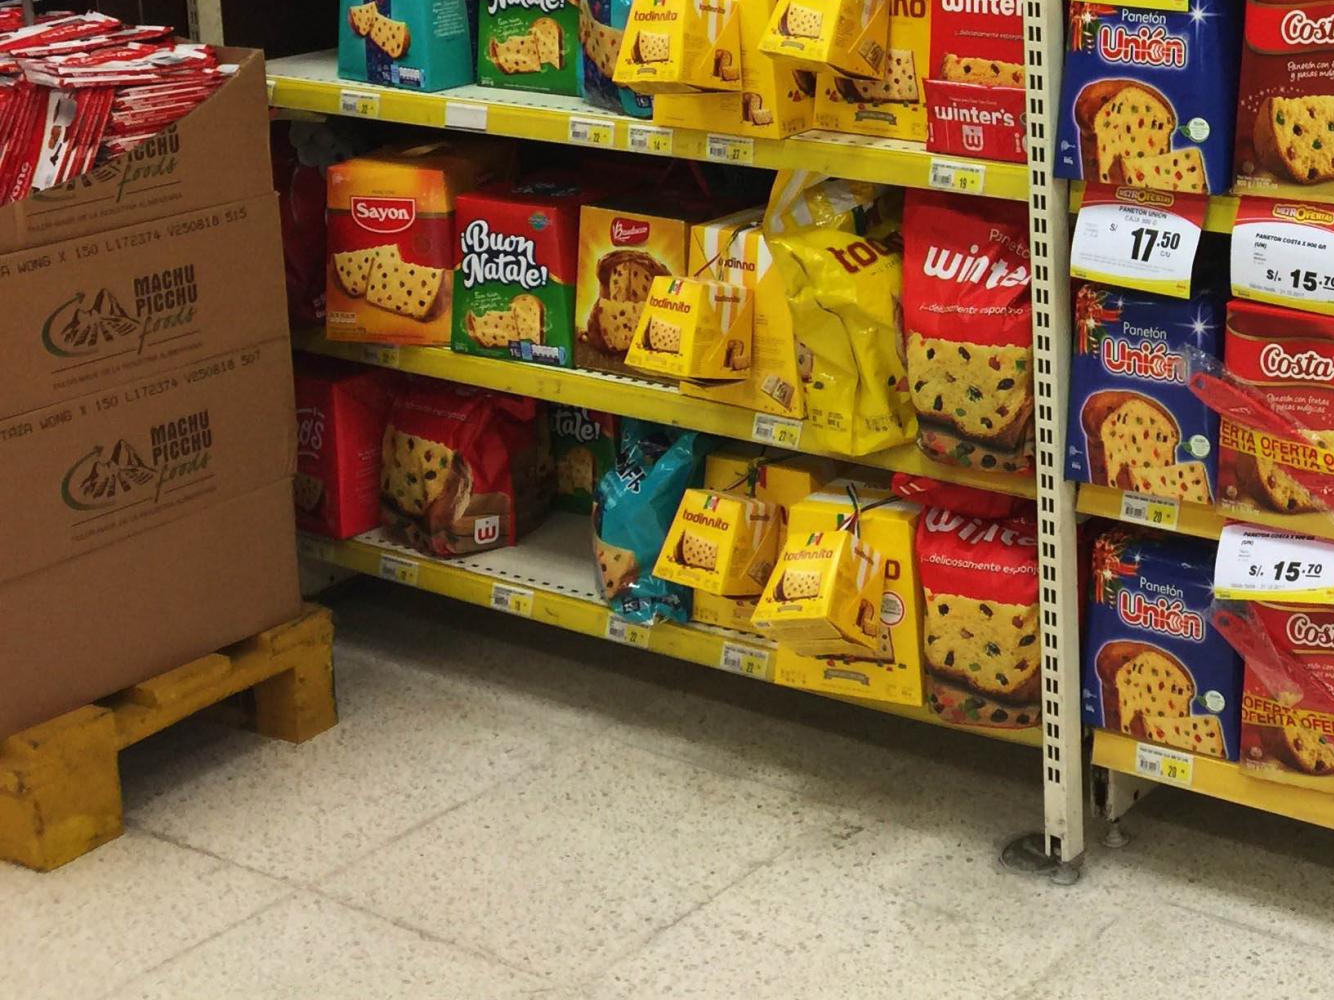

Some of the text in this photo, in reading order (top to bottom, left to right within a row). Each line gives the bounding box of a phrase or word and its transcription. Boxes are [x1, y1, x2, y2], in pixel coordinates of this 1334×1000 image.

[1122, 8, 1167, 25] Panetón
[1100, 27, 1187, 68] Unión
[934, 104, 1014, 127] winter's
[356, 203, 409, 221] Sayon
[1109, 223, 1181, 262] S/ 17.50
[134, 264, 195, 296] MACHU
[463, 253, 547, 288] Natale!
[1266, 269, 1281, 281] S/.
[136, 284, 198, 317] PICCHU
[1123, 321, 1167, 339] Panetón
[1102, 338, 1188, 384] Unión
[151, 408, 209, 441] MACHU
[153, 428, 212, 465] PICCHU
[1261, 436, 1318, 462] OFERTA
[1140, 576, 1183, 598] Panetón
[1249, 561, 1322, 582] S/. 15.70
[1118, 591, 1204, 643] Unión
